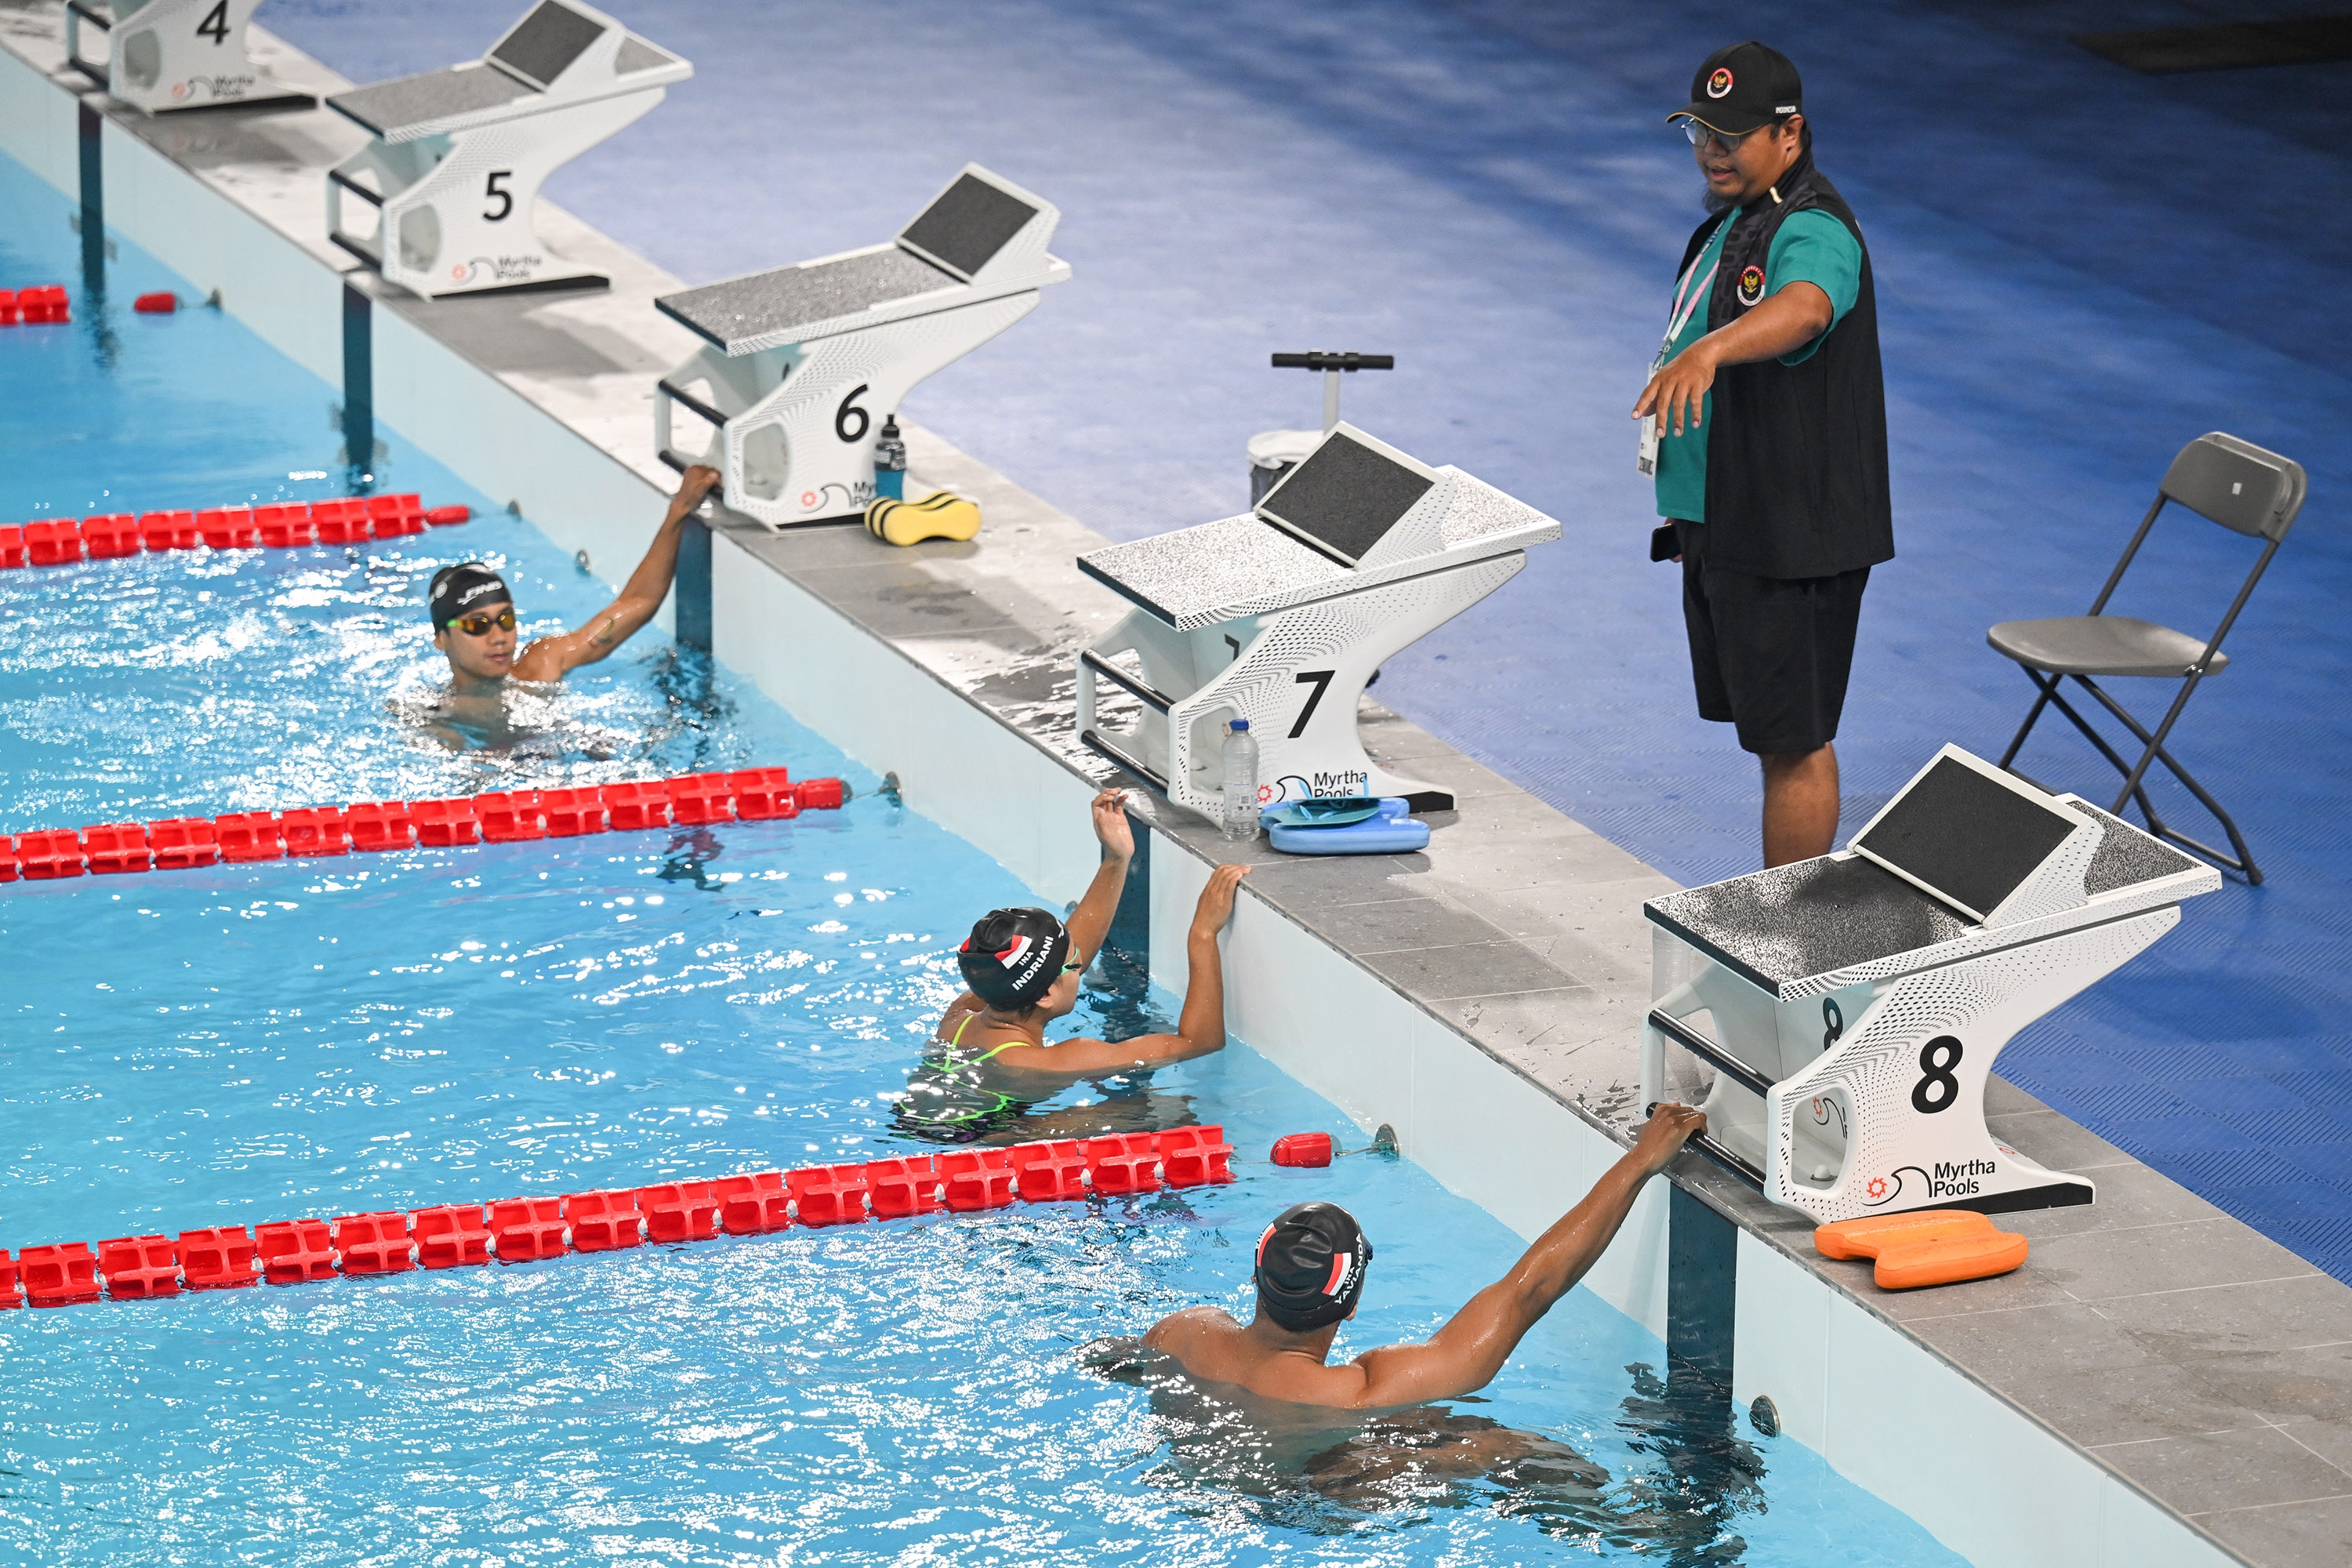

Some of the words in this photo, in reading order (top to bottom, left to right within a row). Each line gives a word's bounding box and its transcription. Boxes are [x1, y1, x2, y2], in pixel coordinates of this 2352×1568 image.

[197, 0, 230, 45] 4
[483, 171, 513, 222] 5
[836, 383, 869, 443] 6
[1287, 670, 1336, 739] 7
[1314, 770, 1367, 789] Myrtha
[1314, 786, 1354, 799] Pools
[1011, 935, 1054, 991] INDRIANI
[1018, 951, 1035, 967] INA
[1911, 1034, 1964, 1114] 8
[1933, 1178, 1980, 1198] Pools
[1934, 1159, 1996, 1181] Myrtha
[1334, 1232, 1363, 1305] YAVIANDA
[1344, 1266, 1356, 1284] INA
